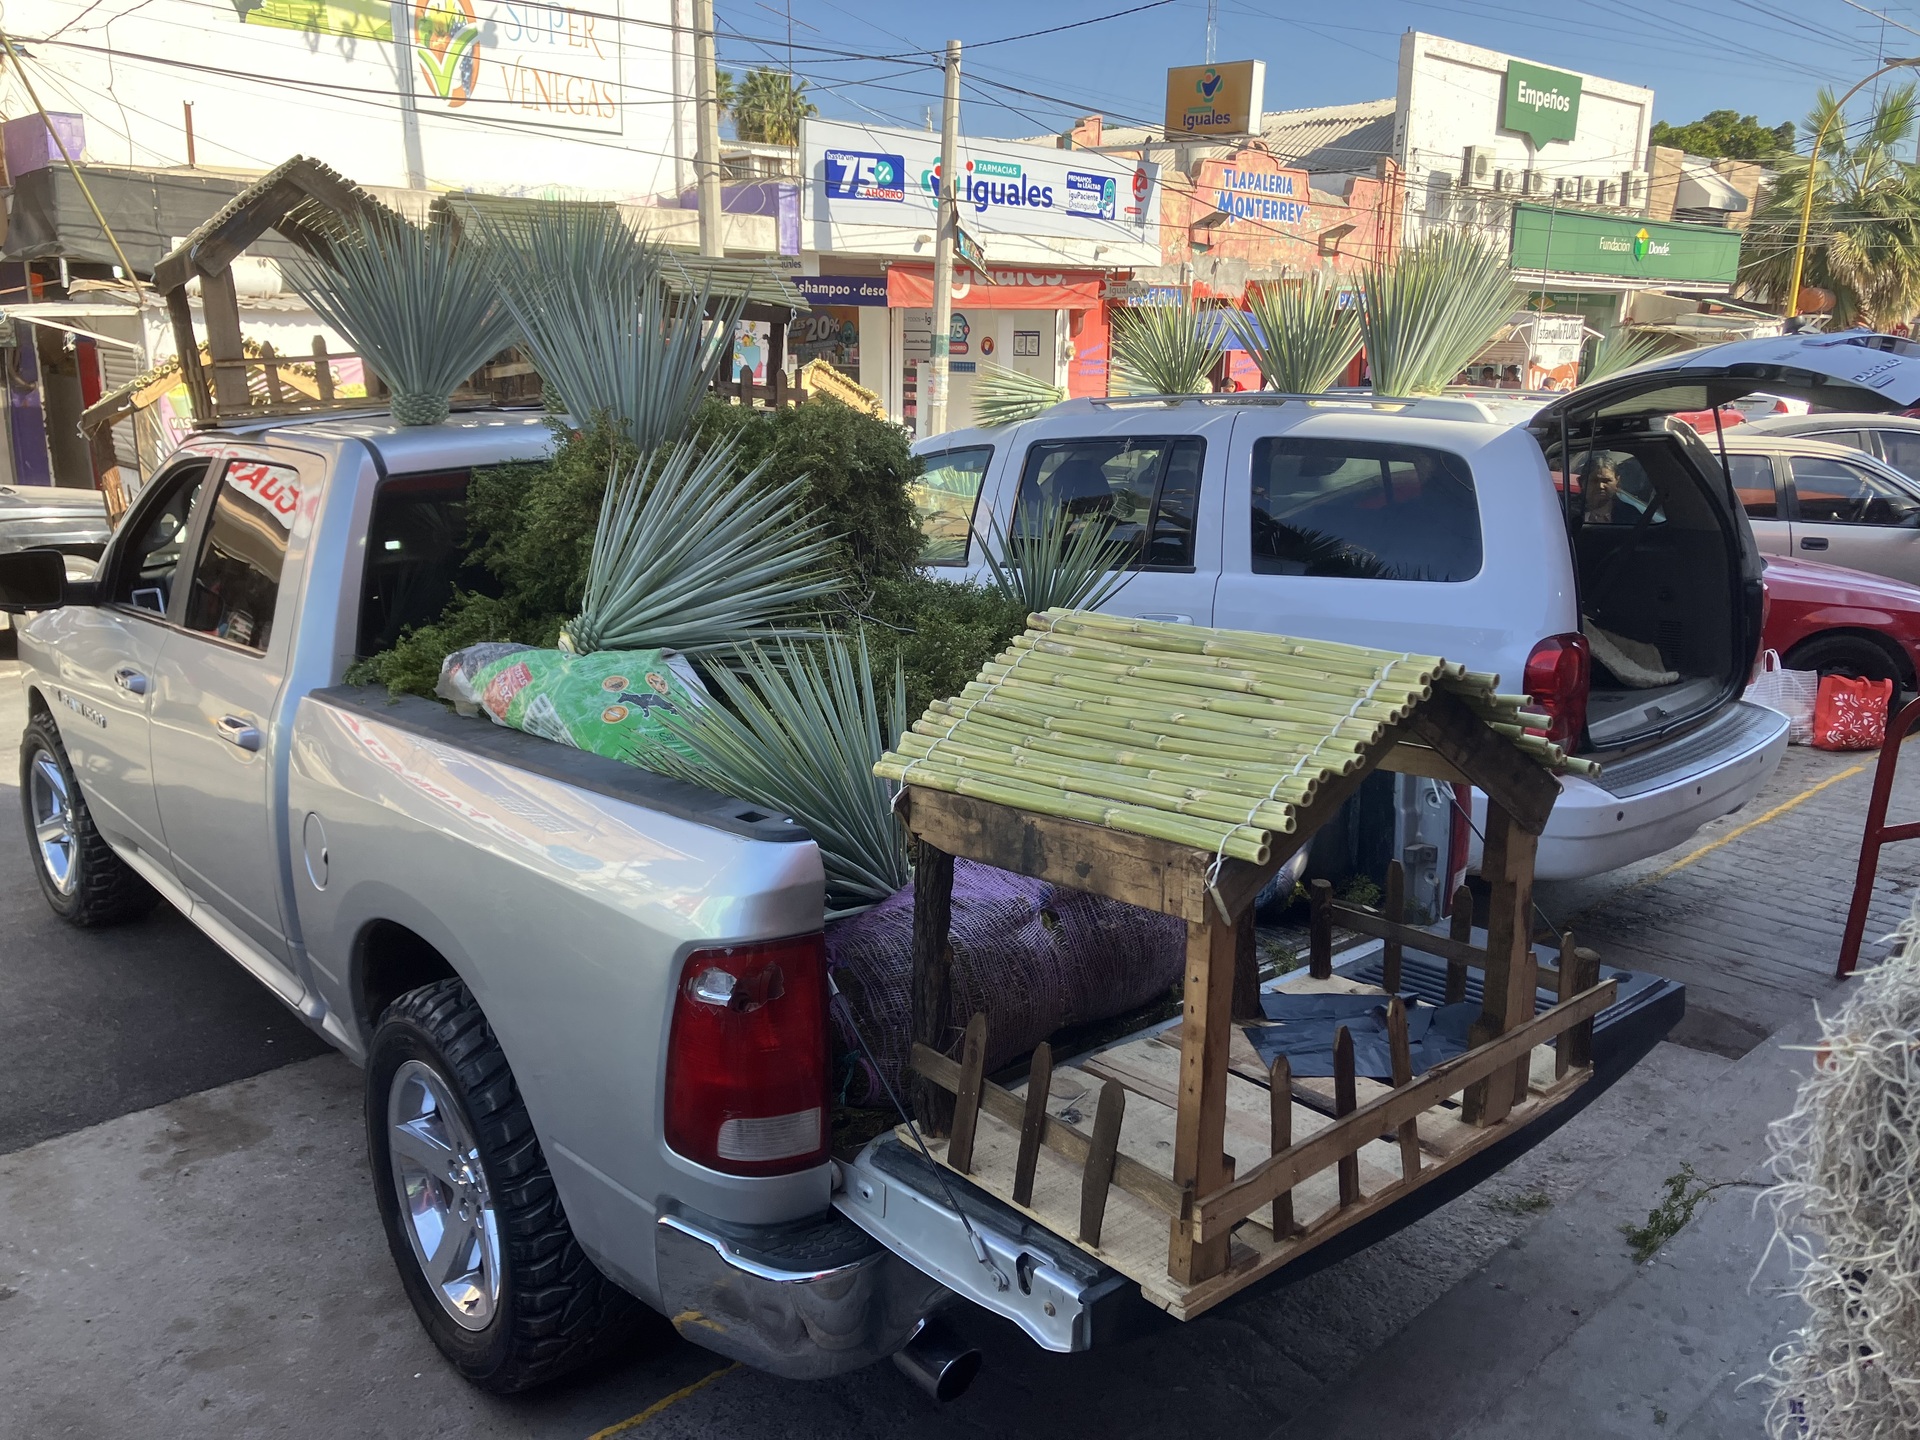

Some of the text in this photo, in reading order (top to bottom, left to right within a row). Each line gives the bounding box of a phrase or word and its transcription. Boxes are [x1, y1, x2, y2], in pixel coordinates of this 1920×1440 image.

[504, 1, 605, 60] SUPER
[501, 55, 616, 119] VENEGAS
[1517, 80, 1571, 112] Empeños
[827, 152, 845, 160] hasta
[978, 163, 1018, 176] FARMACIAS
[1068, 174, 1092, 183] PREMIAMOS
[1223, 168, 1294, 195] TLAPALERIA
[865, 188, 904, 200] AHORRO
[1068, 190, 1099, 202] iguPaciente
[1068, 201, 1098, 211] Distinguido
[1599, 236, 1670, 254] Fundación Dondé
[798, 280, 888, 297] shampoo deso
[805, 315, 841, 341] 20%
